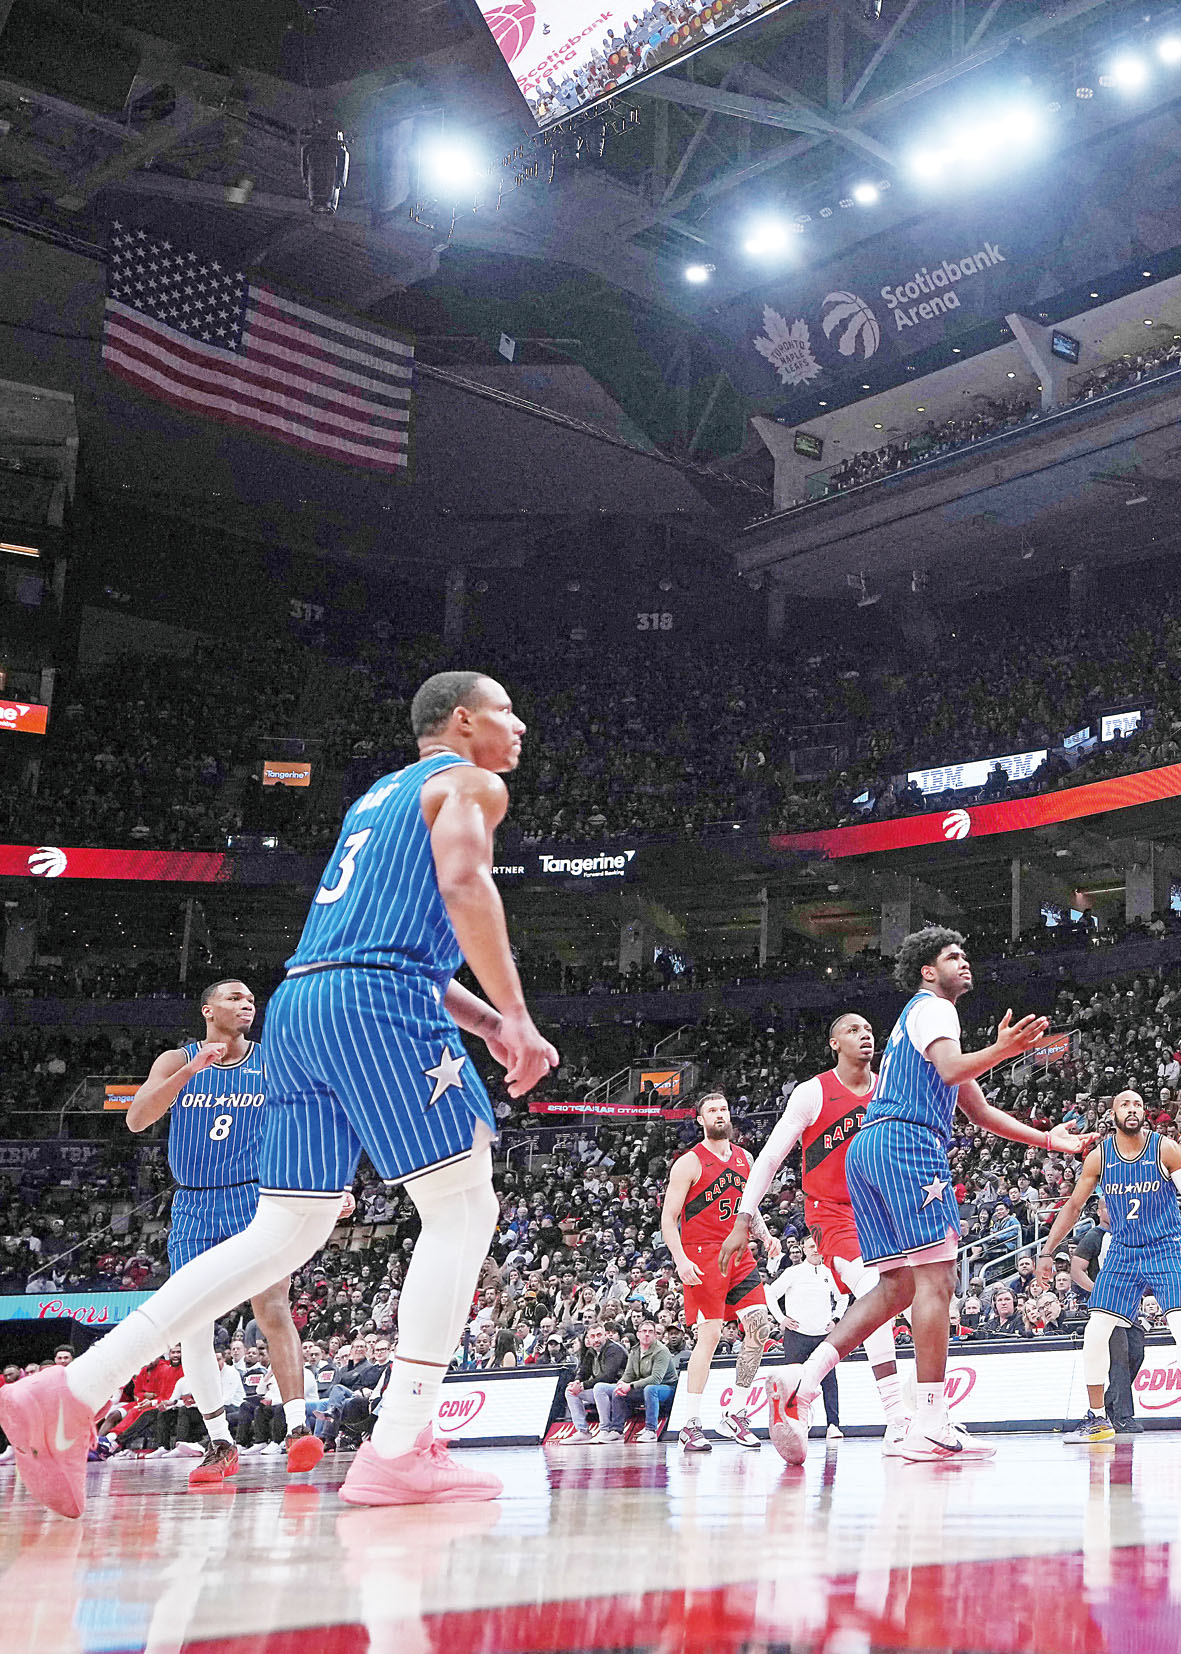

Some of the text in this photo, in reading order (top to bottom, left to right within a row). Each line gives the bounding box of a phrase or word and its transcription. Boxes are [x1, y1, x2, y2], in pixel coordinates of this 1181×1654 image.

[516, 11, 613, 87] Scotiabank
[522, 51, 578, 95] Arena
[880, 242, 1007, 310] Scotiabank
[893, 290, 961, 331] Arena
[771, 339, 805, 360] TORONTO
[785, 359, 809, 374] LEAFS
[636, 612, 674, 631] 318
[266, 769, 305, 780] Tangerine
[921, 766, 965, 793] IBM
[315, 827, 374, 906] 3
[491, 852, 625, 876] RTNER Tangerine
[208, 1113, 233, 1141] 8
[1126, 1198, 1141, 1220] 2
[38, 1299, 109, 1323] Coors
[438, 1399, 475, 1418] CDW
[719, 1386, 763, 1407] CW
